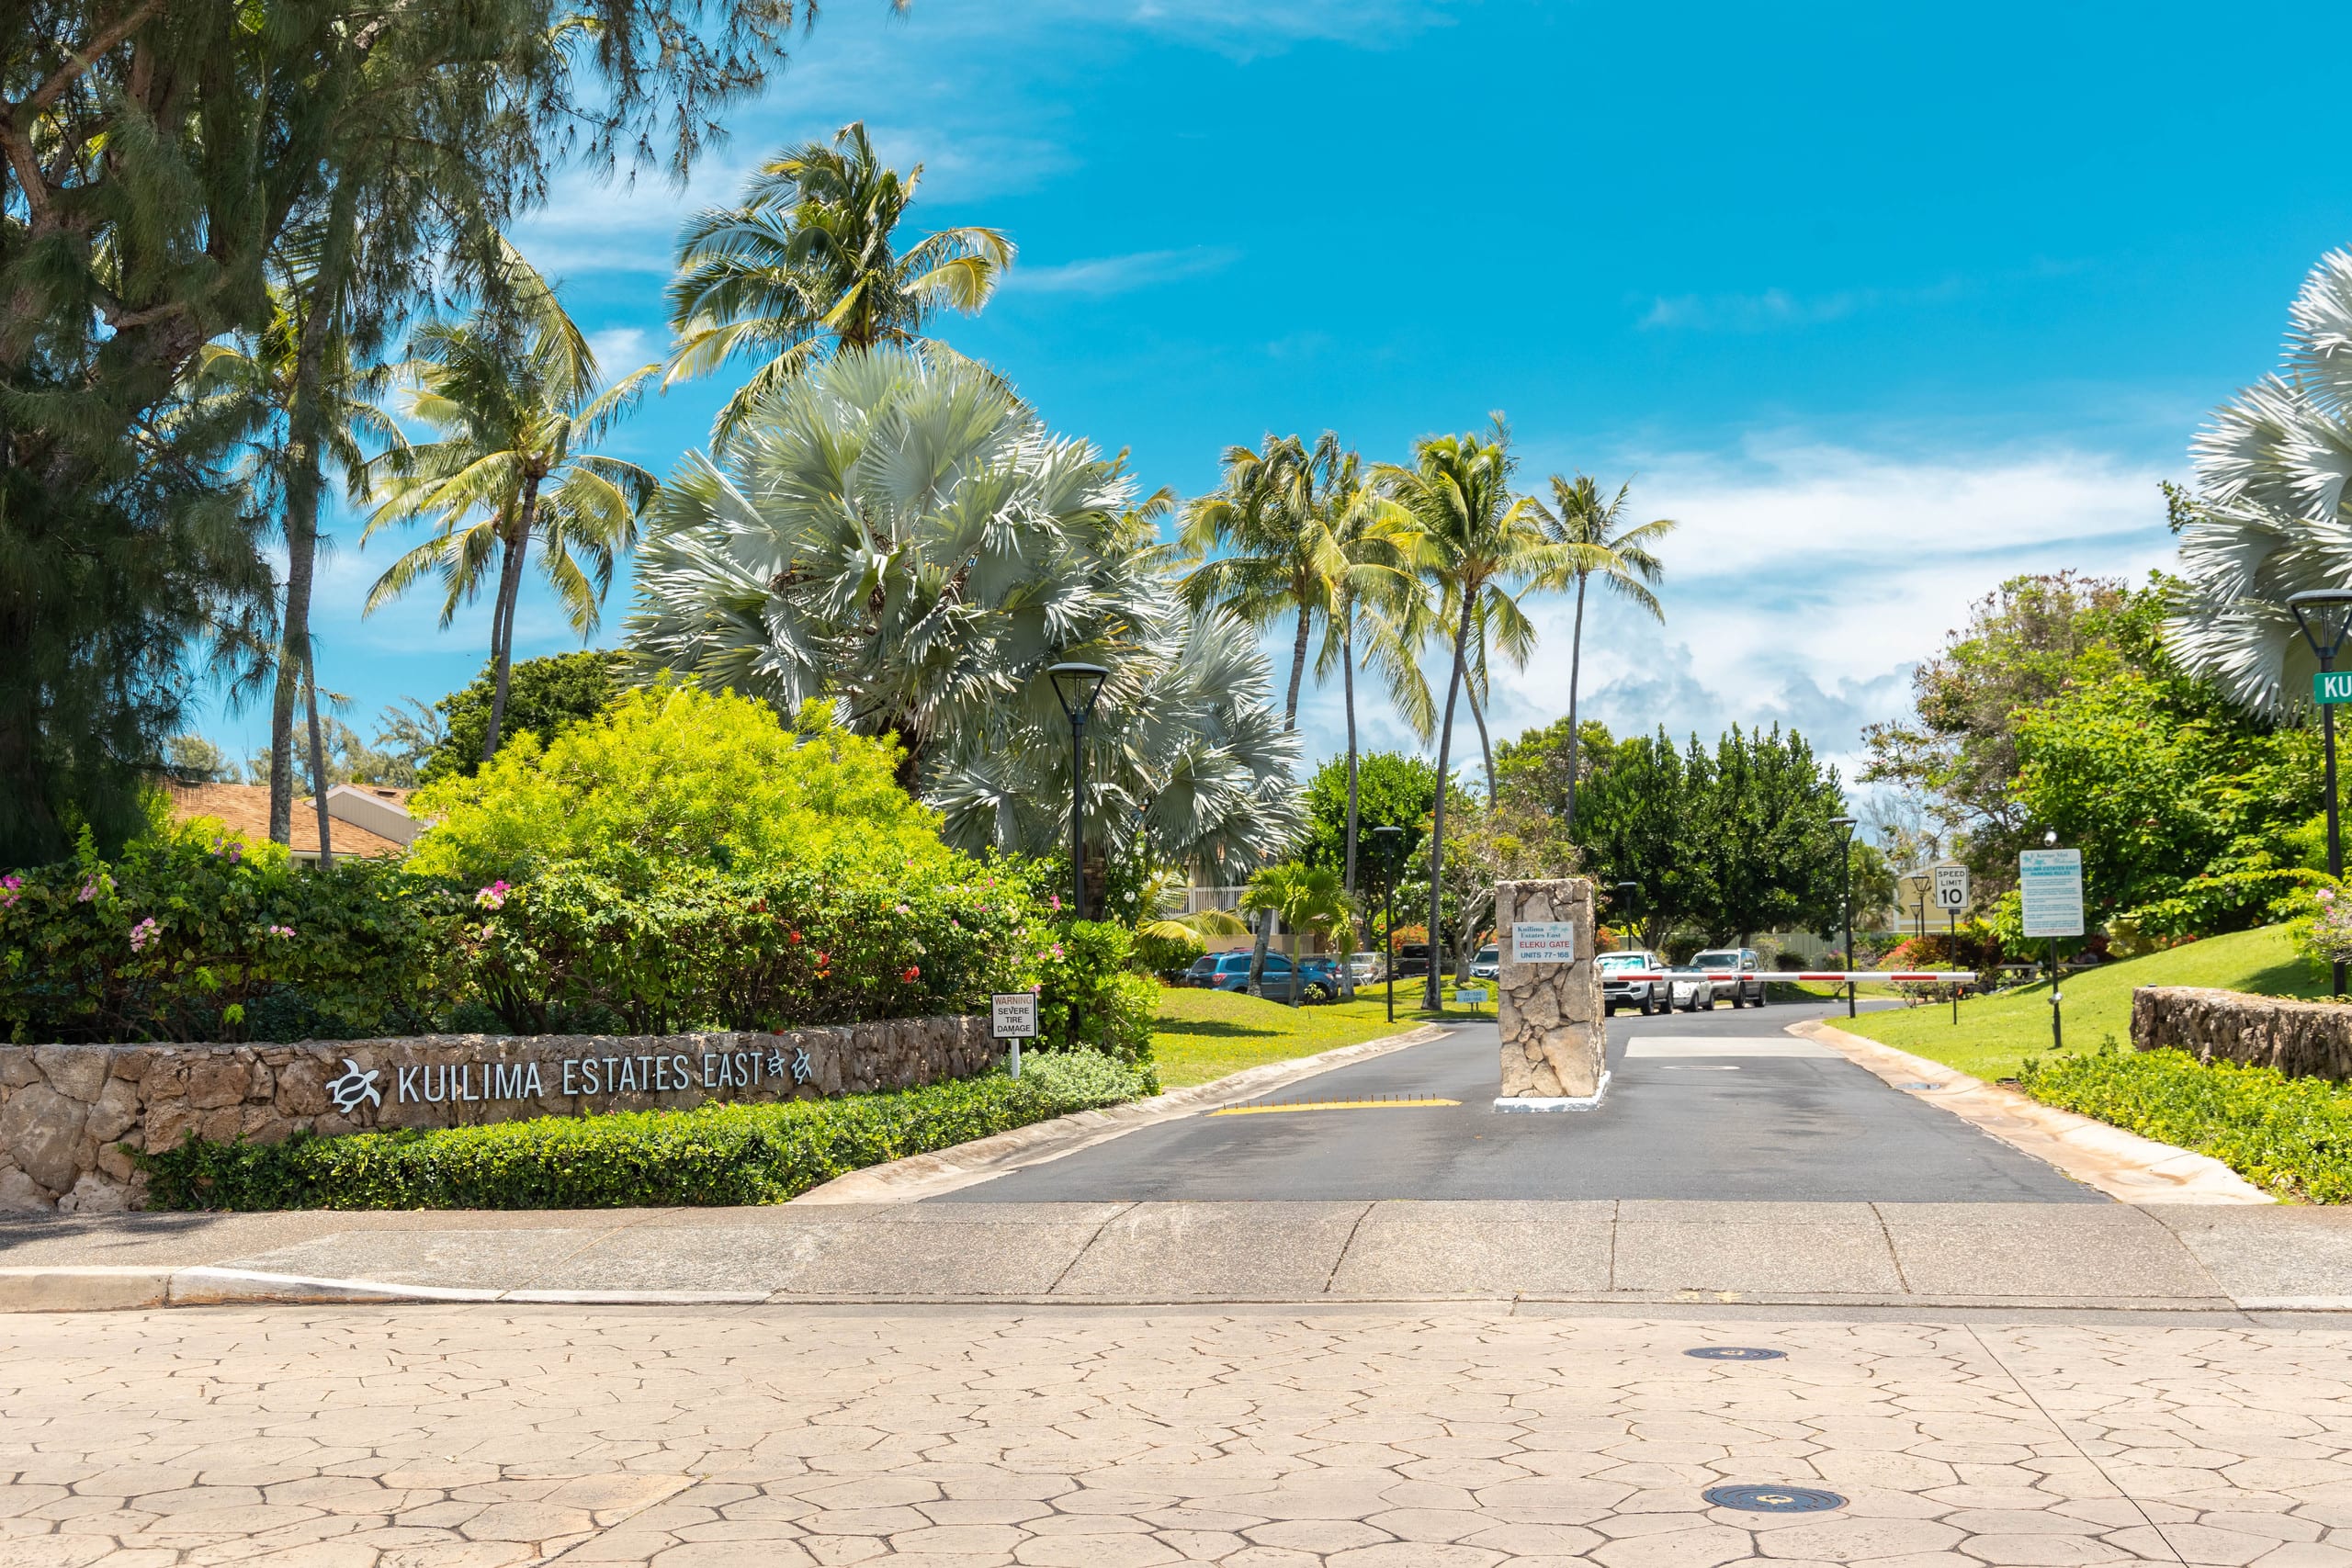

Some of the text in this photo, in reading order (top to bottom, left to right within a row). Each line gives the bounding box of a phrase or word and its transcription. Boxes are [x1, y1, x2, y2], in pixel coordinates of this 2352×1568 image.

[1941, 889, 1962, 904] 10
[995, 996, 1032, 1005] WARNING
[398, 1051, 763, 1103] KUILIMA ESTATES EAST
